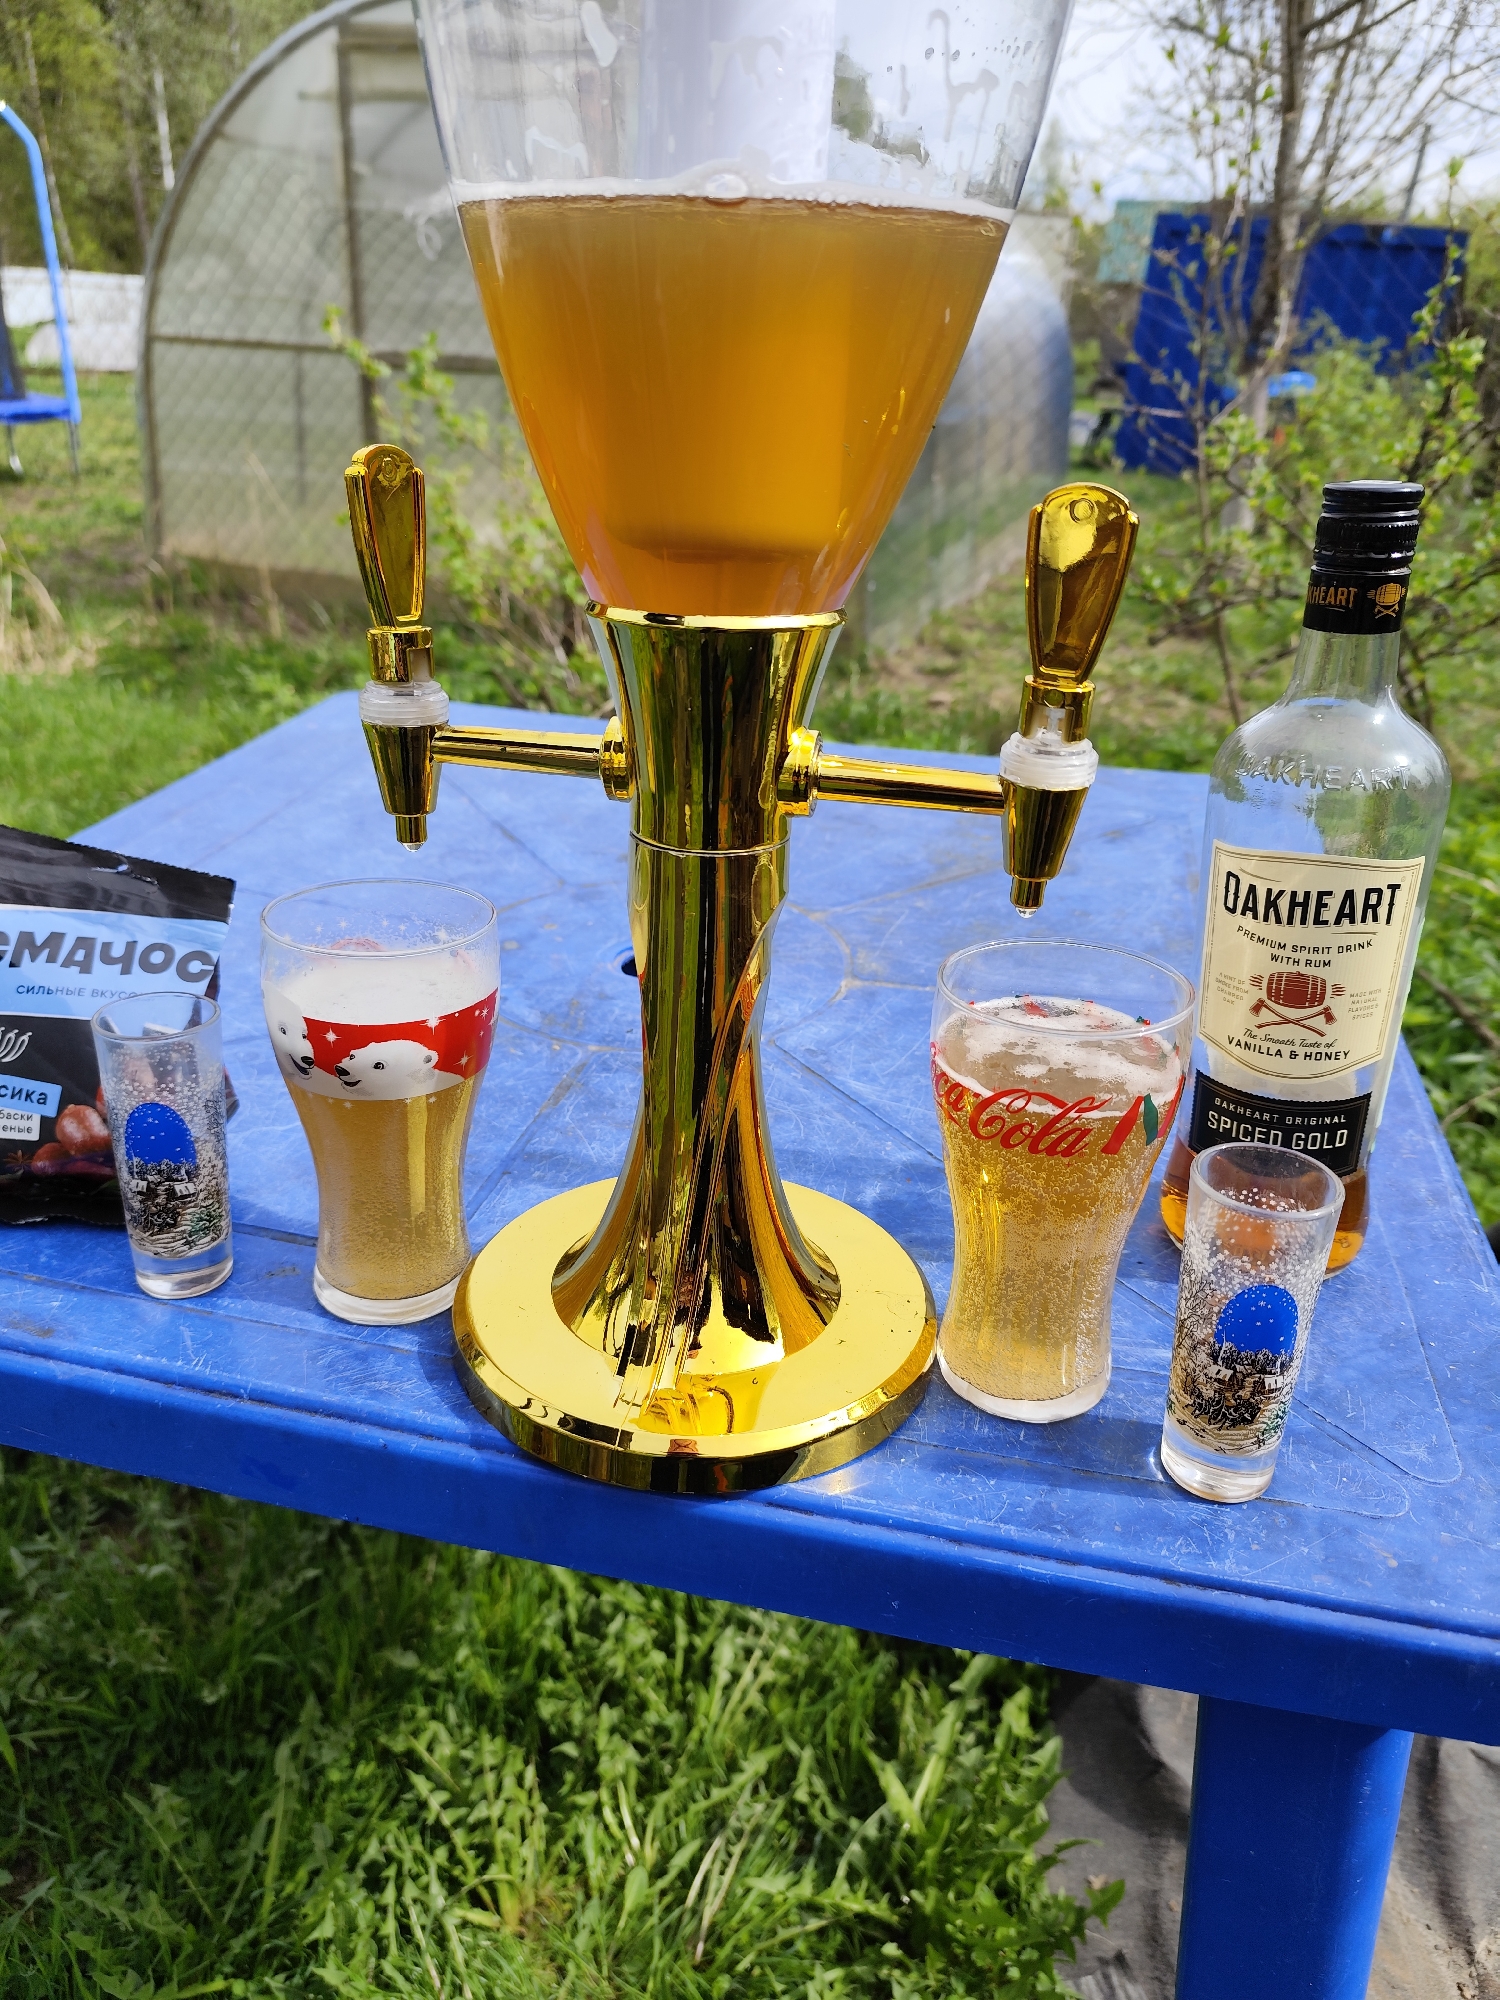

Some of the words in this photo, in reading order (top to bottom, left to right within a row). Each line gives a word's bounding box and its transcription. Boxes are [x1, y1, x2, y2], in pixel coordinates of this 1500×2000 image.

[1235, 751, 1411, 792] OAKHEART
[1223, 870, 1402, 928] OAKHEART
[1236, 925, 1287, 951] PREMIUM
[1291, 944, 1333, 955] SPIRIT
[1337, 938, 1373, 954] DRINK
[0, 930, 216, 983] МАЧОС
[1270, 952, 1301, 967] WITH
[1304, 959, 1332, 968] RUM
[16, 984, 87, 997] СИЛЬНЫЕ
[91, 988, 146, 1000] ВКУСО
[1227, 1034, 1283, 1059] VANILLA
[1289, 1049, 1300, 1060] &
[1303, 1049, 1351, 1061] HONEY
[1243, 1028, 1258, 1040] The
[1259, 1033, 1297, 1047] Smooth
[1298, 1038, 1322, 1049] Taste
[1323, 1038, 1339, 1050] of
[1214, 1097, 1280, 1123] OAKHEART
[1286, 1114, 1347, 1126] ORIGINAL
[1207, 1110, 1283, 1147] SPICED
[1292, 1129, 1348, 1150] GOLD
